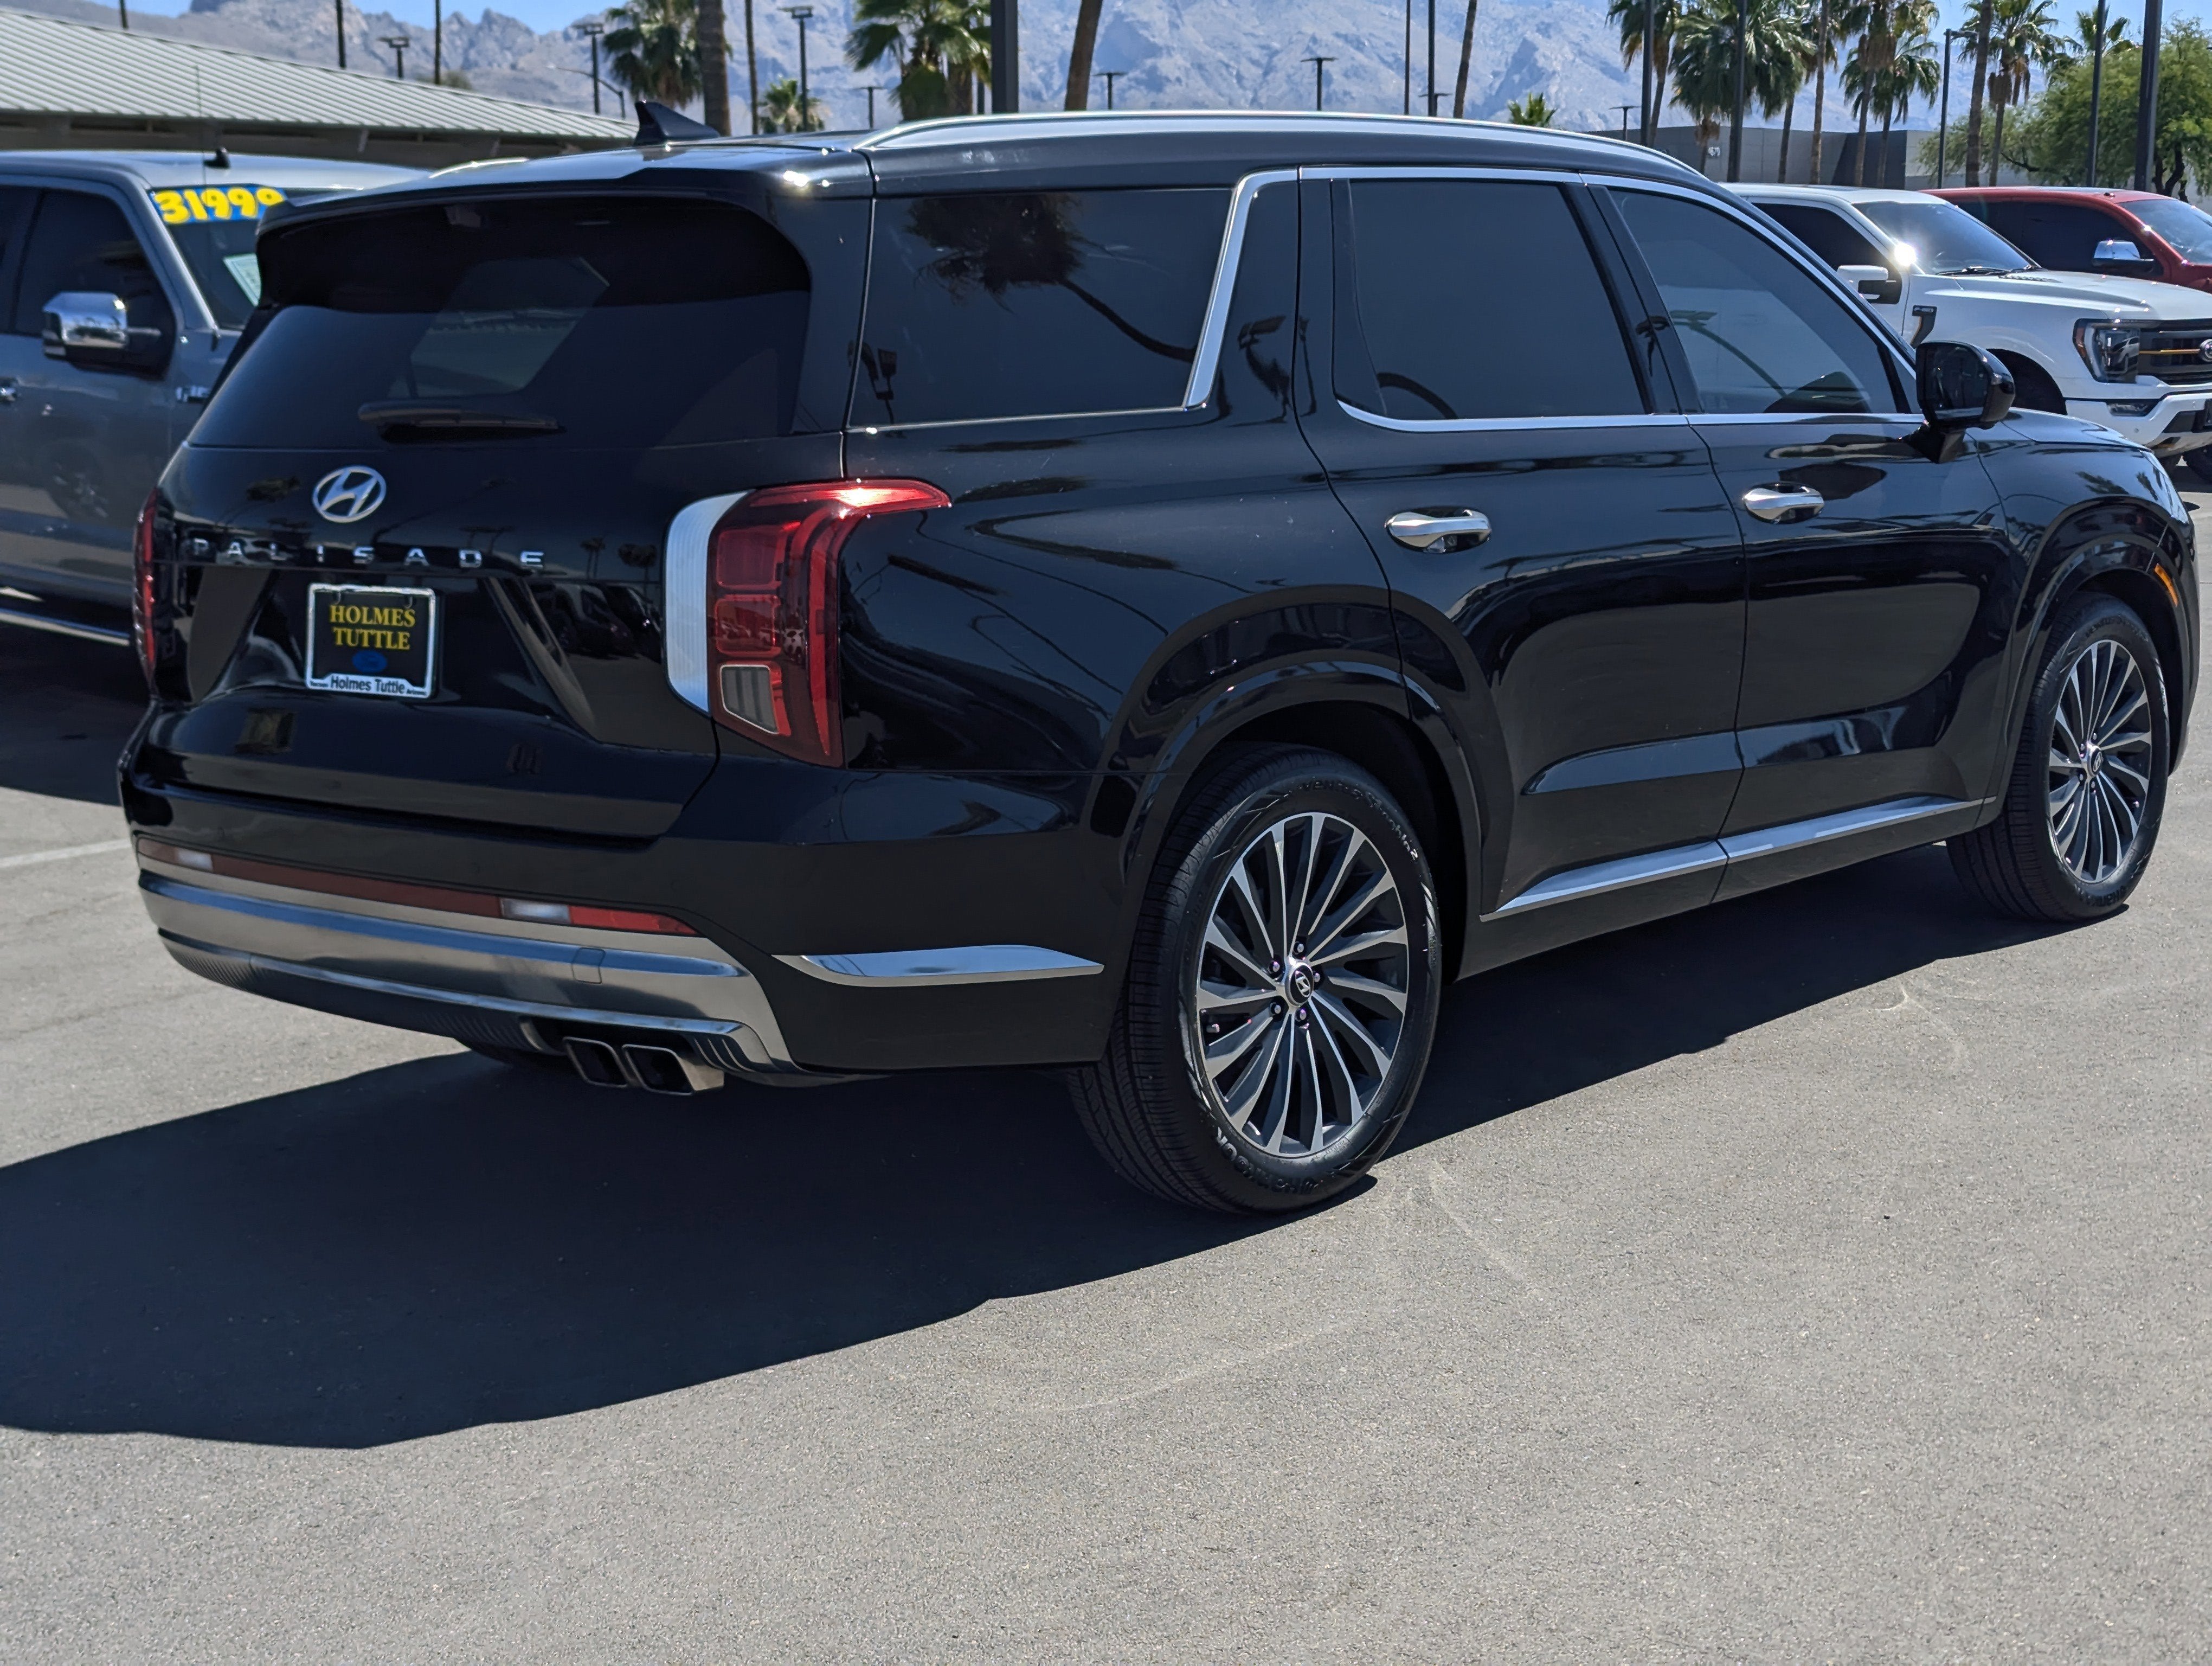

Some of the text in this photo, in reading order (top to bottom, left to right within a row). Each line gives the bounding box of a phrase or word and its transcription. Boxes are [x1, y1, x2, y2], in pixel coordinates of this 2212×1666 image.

[194, 537, 544, 568] PALISADE
[330, 605, 416, 627] HOLMES
[332, 626, 411, 650] TUTTLE
[331, 675, 406, 695] Holmes Tuttle
